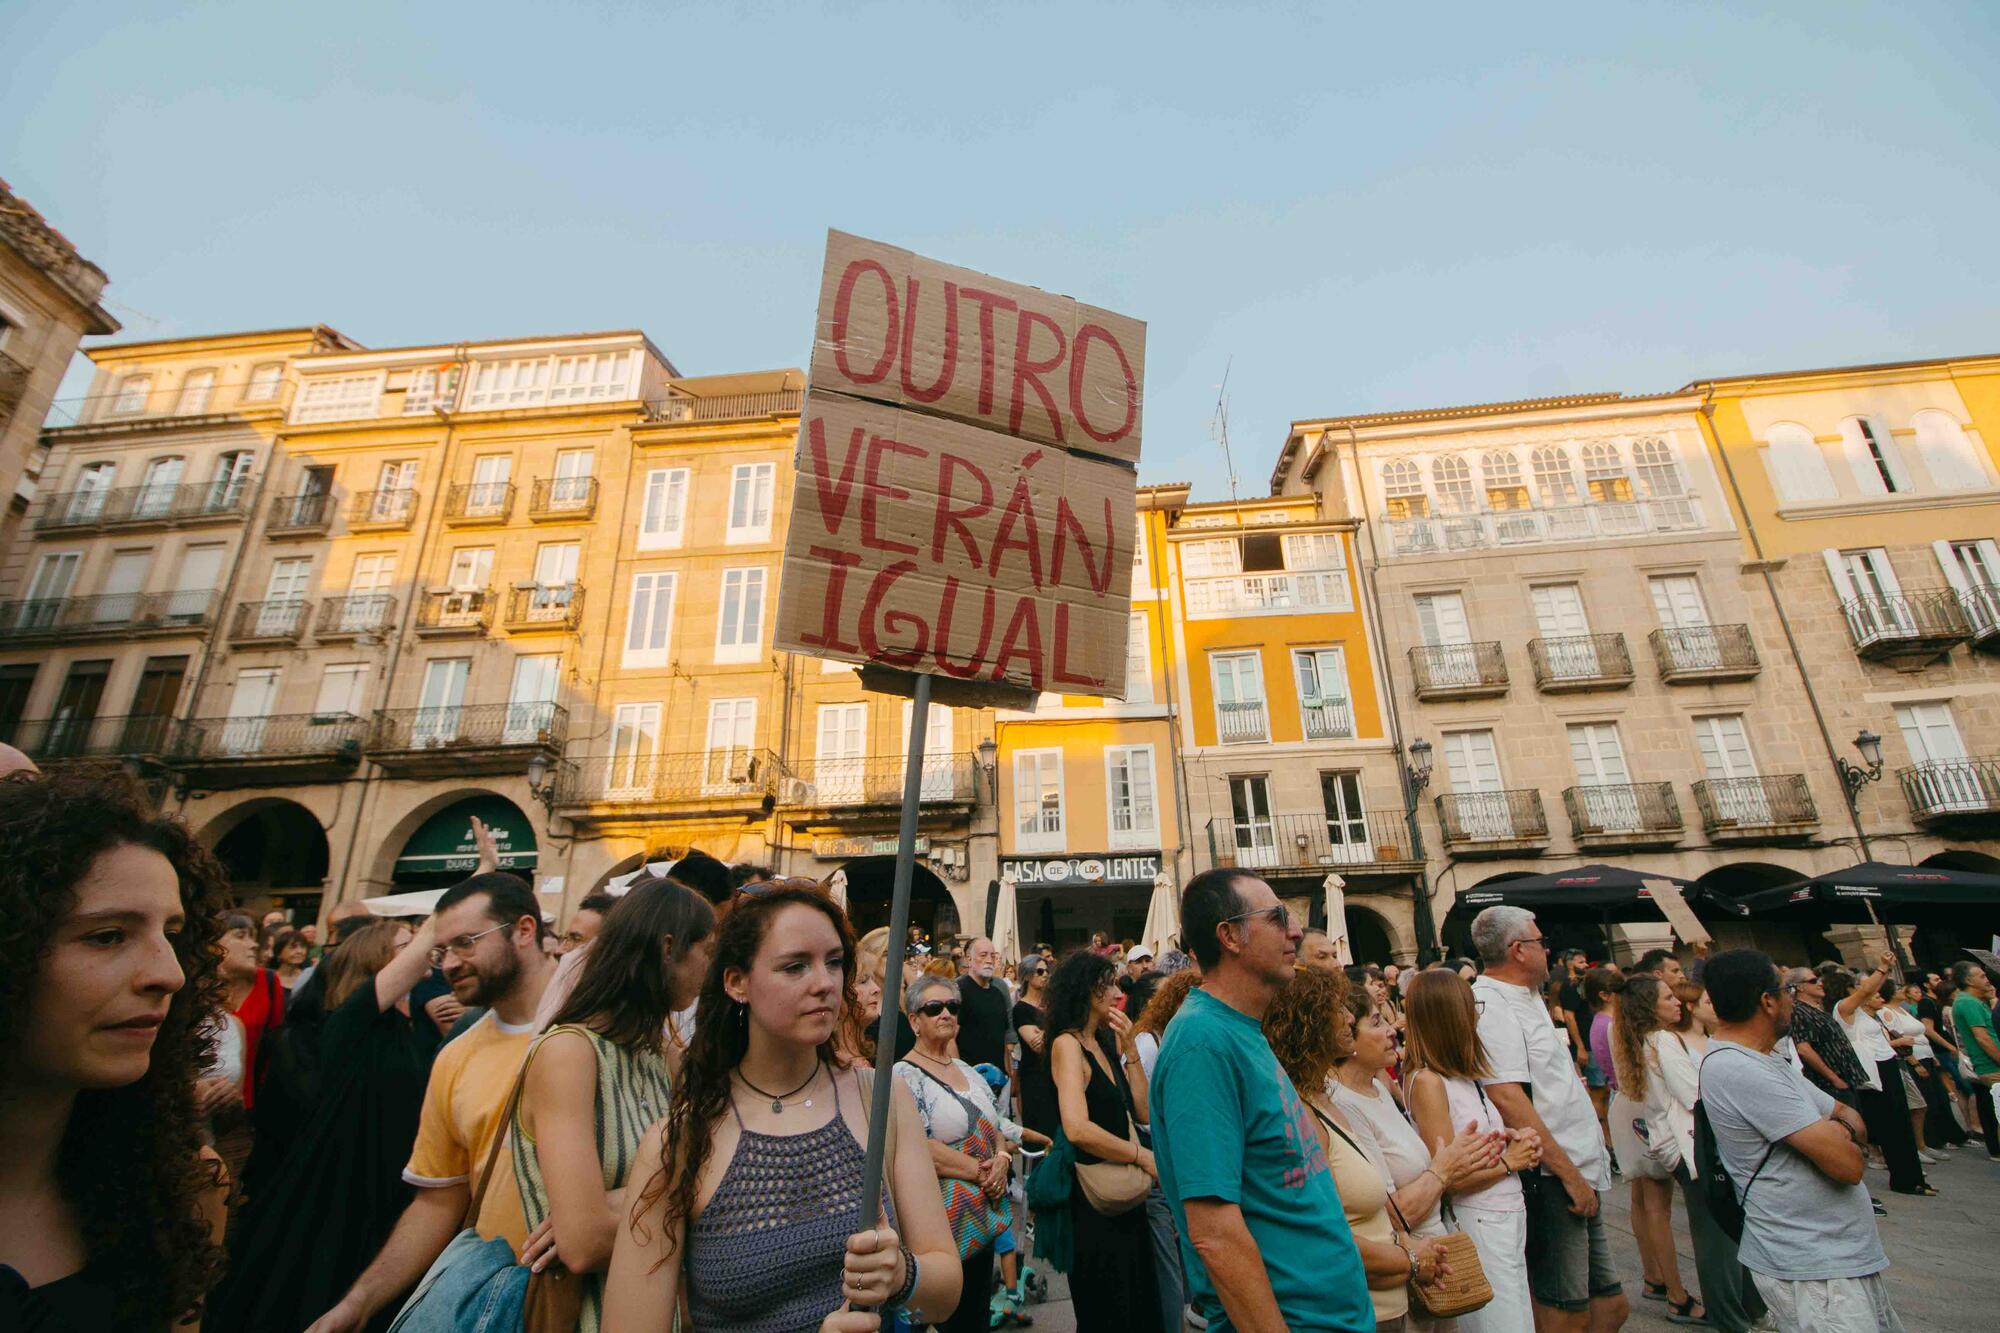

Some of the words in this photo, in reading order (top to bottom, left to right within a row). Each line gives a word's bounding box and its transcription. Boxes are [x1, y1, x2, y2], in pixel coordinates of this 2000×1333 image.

[832, 259, 1137, 445] OUTRO
[808, 417, 1115, 598] VERÁN
[800, 545, 1106, 693] IGUAL
[1049, 866, 1063, 875] DE
[1084, 865, 1099, 873] LOS
[1106, 857, 1157, 880] LENTES
